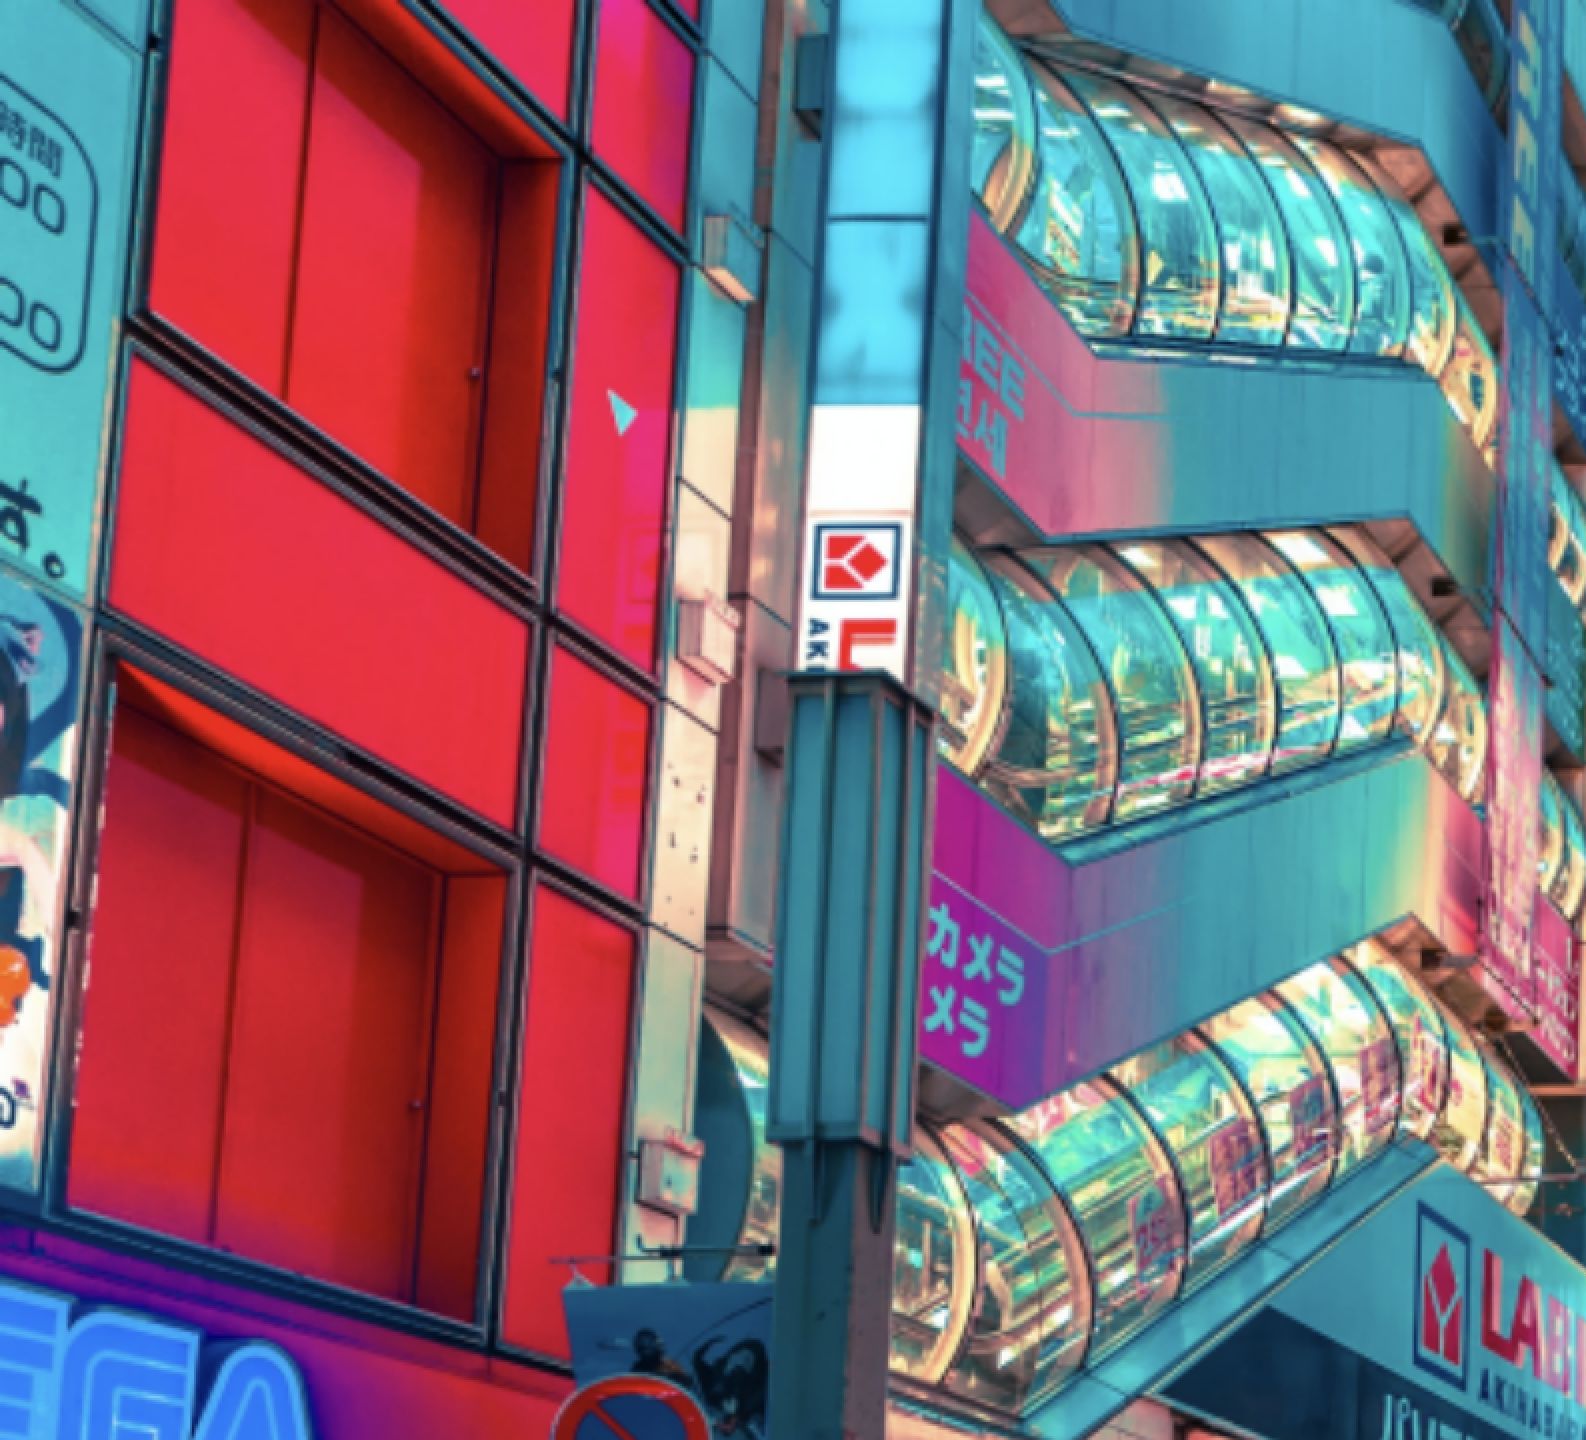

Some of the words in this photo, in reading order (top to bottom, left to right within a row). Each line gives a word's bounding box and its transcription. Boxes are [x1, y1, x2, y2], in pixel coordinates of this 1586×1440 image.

[926, 902, 1025, 1006] カメラ
[924, 983, 990, 1058] メラ
